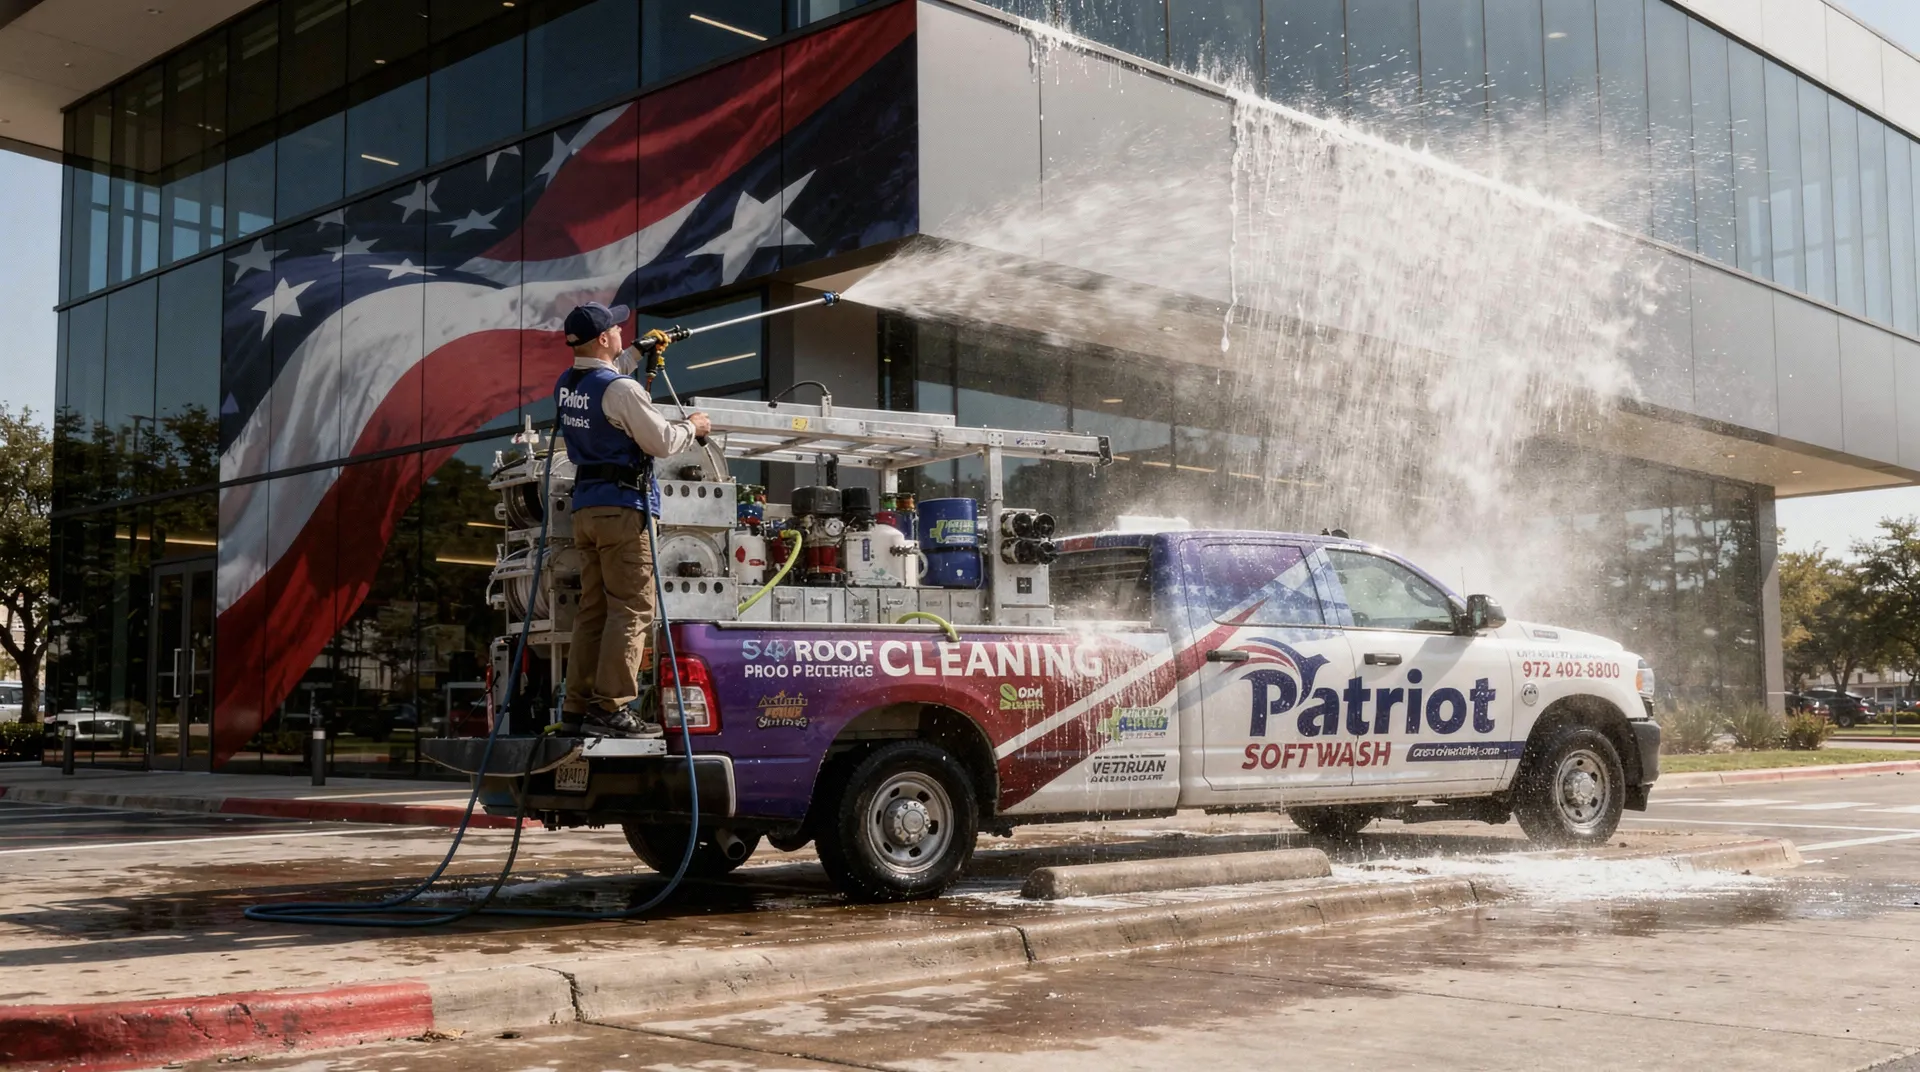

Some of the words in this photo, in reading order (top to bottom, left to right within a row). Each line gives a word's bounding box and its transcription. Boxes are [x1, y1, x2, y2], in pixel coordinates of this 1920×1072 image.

[794, 640, 874, 662] ROOF
[879, 640, 1101, 677] CLEANING
[1522, 661, 1551, 678] 972
[1239, 668, 1497, 737] Patriot
